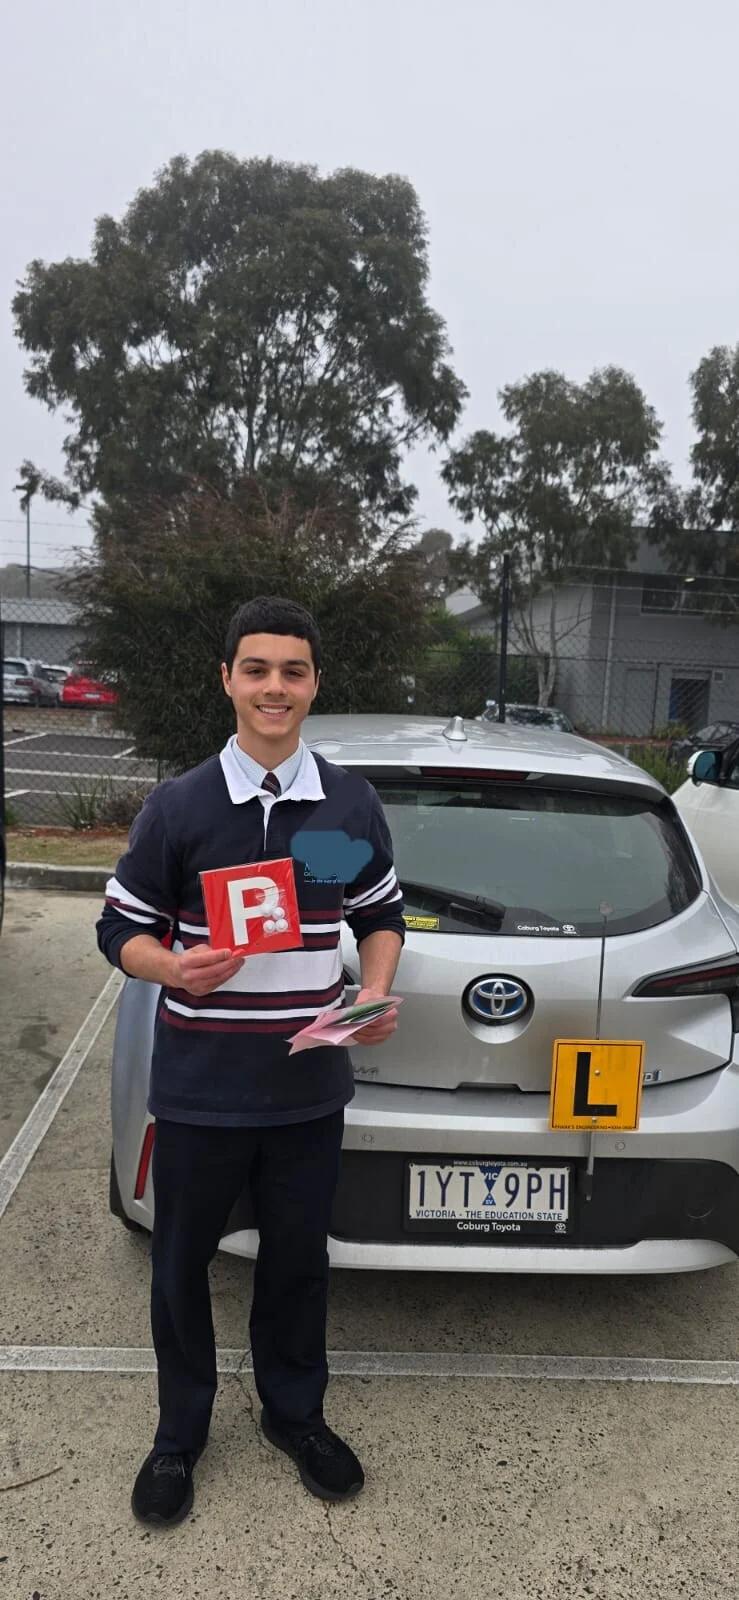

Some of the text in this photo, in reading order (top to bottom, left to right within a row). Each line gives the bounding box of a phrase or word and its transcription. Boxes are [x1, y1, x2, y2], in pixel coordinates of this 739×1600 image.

[227, 876, 280, 947] P
[573, 1051, 618, 1117] L
[484, 1172, 499, 1181] VIC
[417, 1170, 566, 1210] 1YT 9PH
[415, 1209, 457, 1218] VICTORIA
[466, 1210, 482, 1219] THE
[485, 1211, 534, 1220] EDUCATION
[537, 1212, 563, 1221] STATE
[456, 1221, 521, 1233] Coburg Toyota
